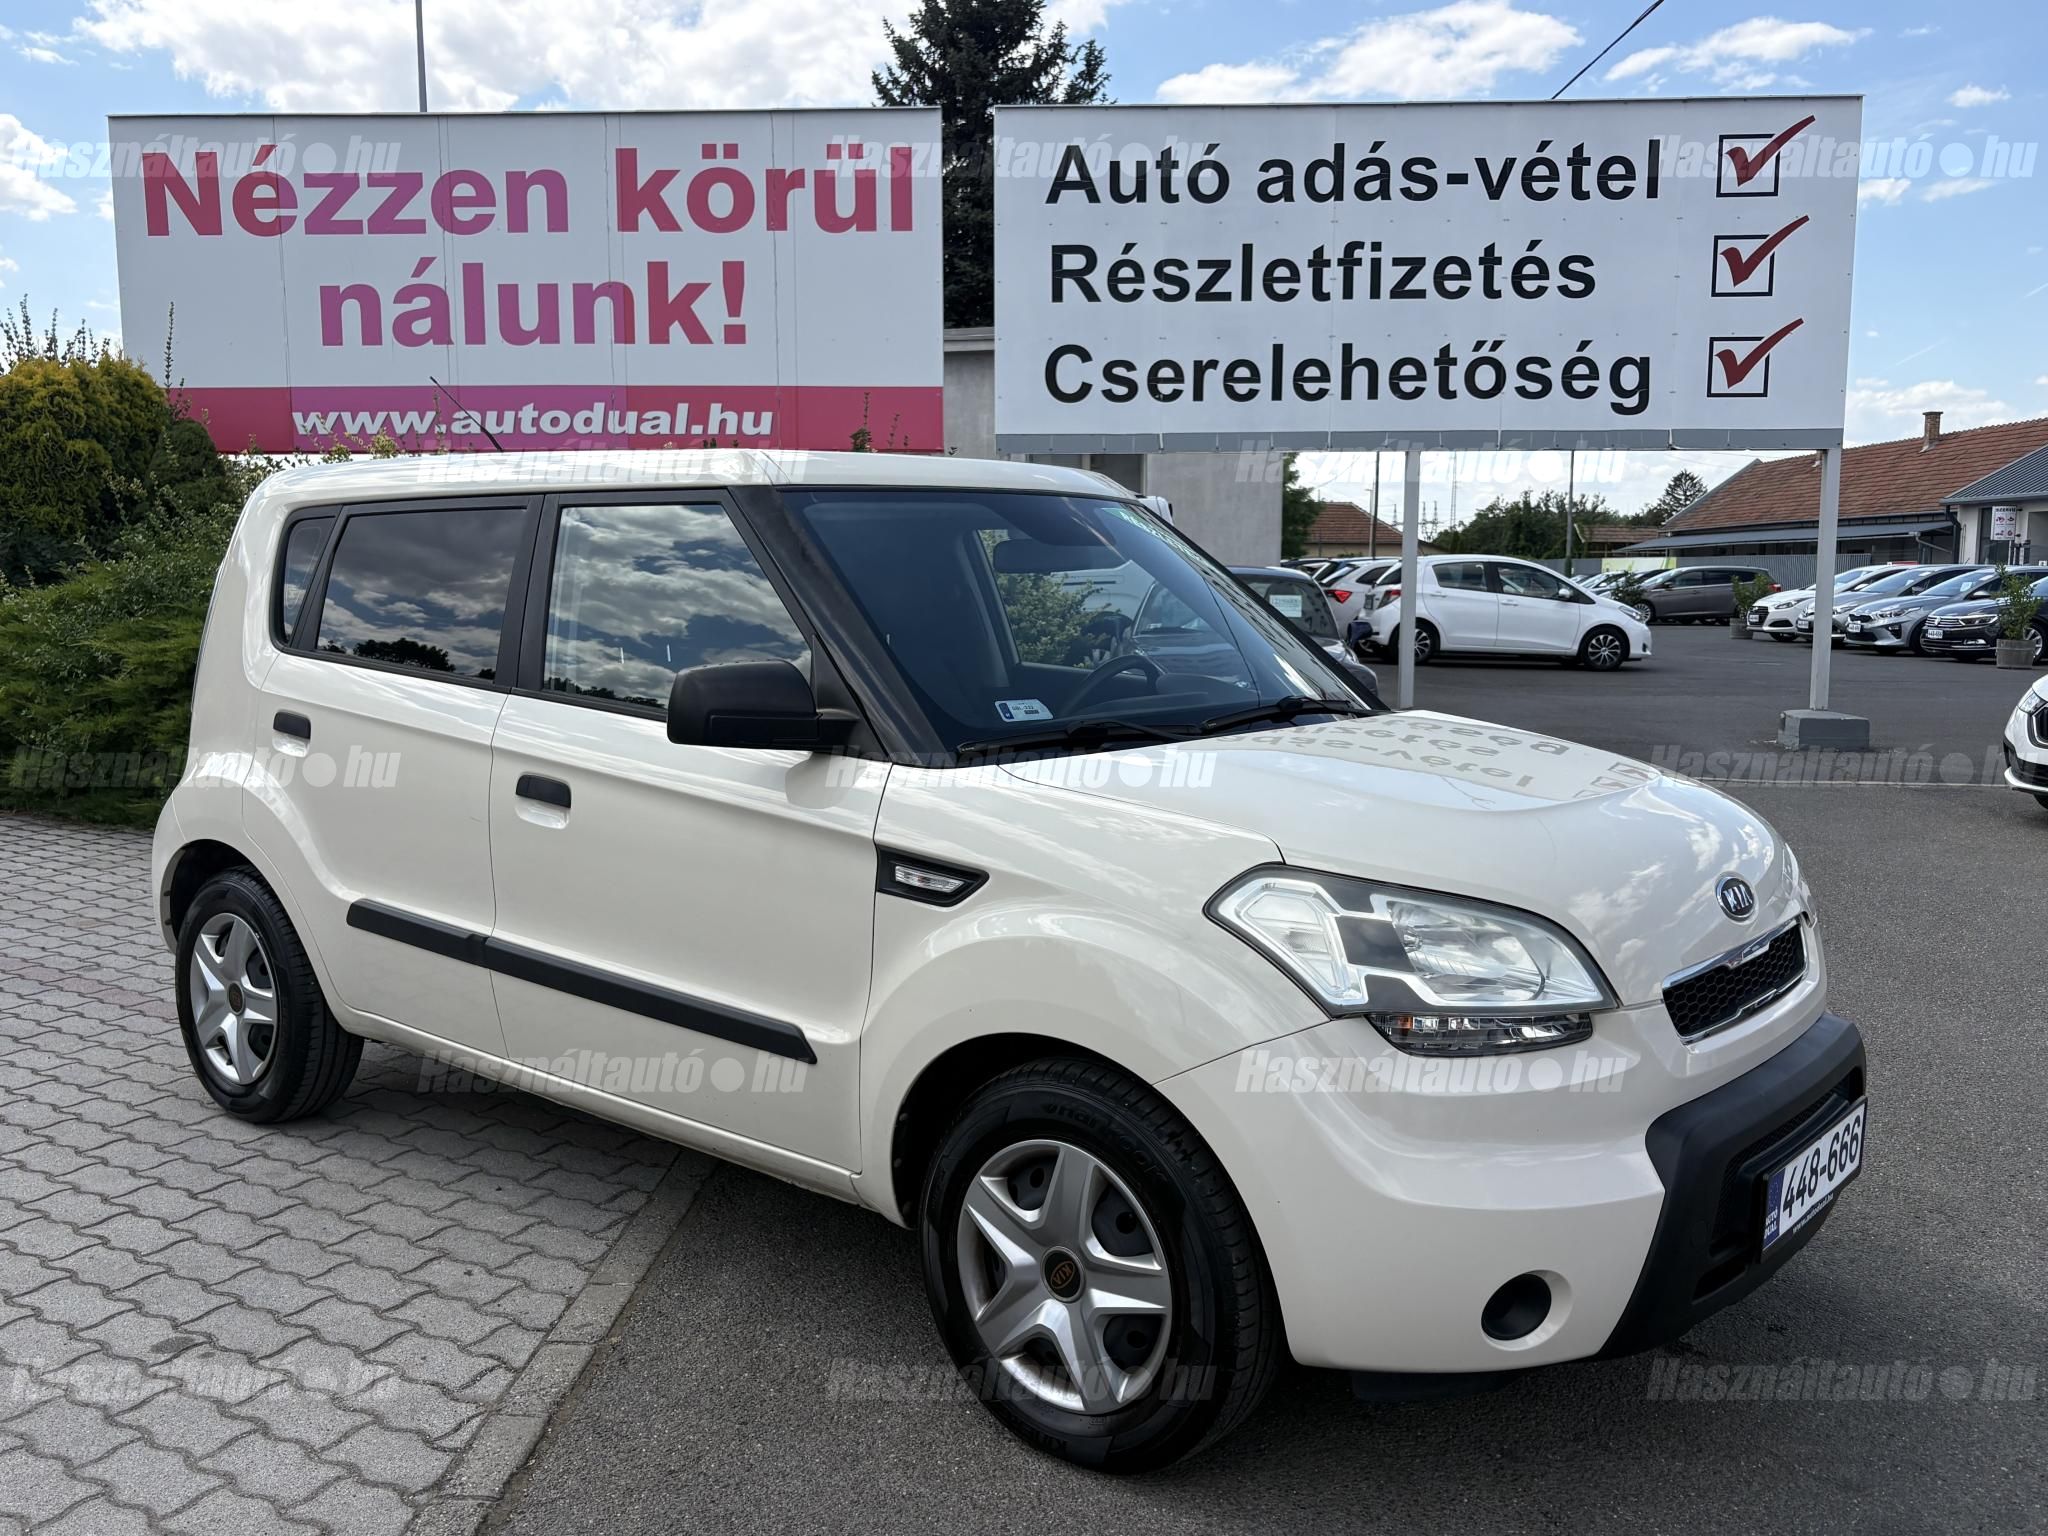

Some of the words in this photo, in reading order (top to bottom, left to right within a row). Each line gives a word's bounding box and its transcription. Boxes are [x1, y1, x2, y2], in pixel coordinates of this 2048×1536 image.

[142, 143, 569, 237] Nézzen
[616, 142, 914, 234] körül
[1045, 141, 1231, 206] Autó
[1257, 136, 1661, 203] adás-vétel
[319, 255, 748, 348] nálunk!
[1050, 238, 1596, 304] Részletfizetés
[1044, 338, 1651, 416] Cserelehetőség
[292, 400, 775, 438] www.autodual.hu
[1722, 884, 1753, 912] KIA
[1782, 1114, 1861, 1219] 448-666
